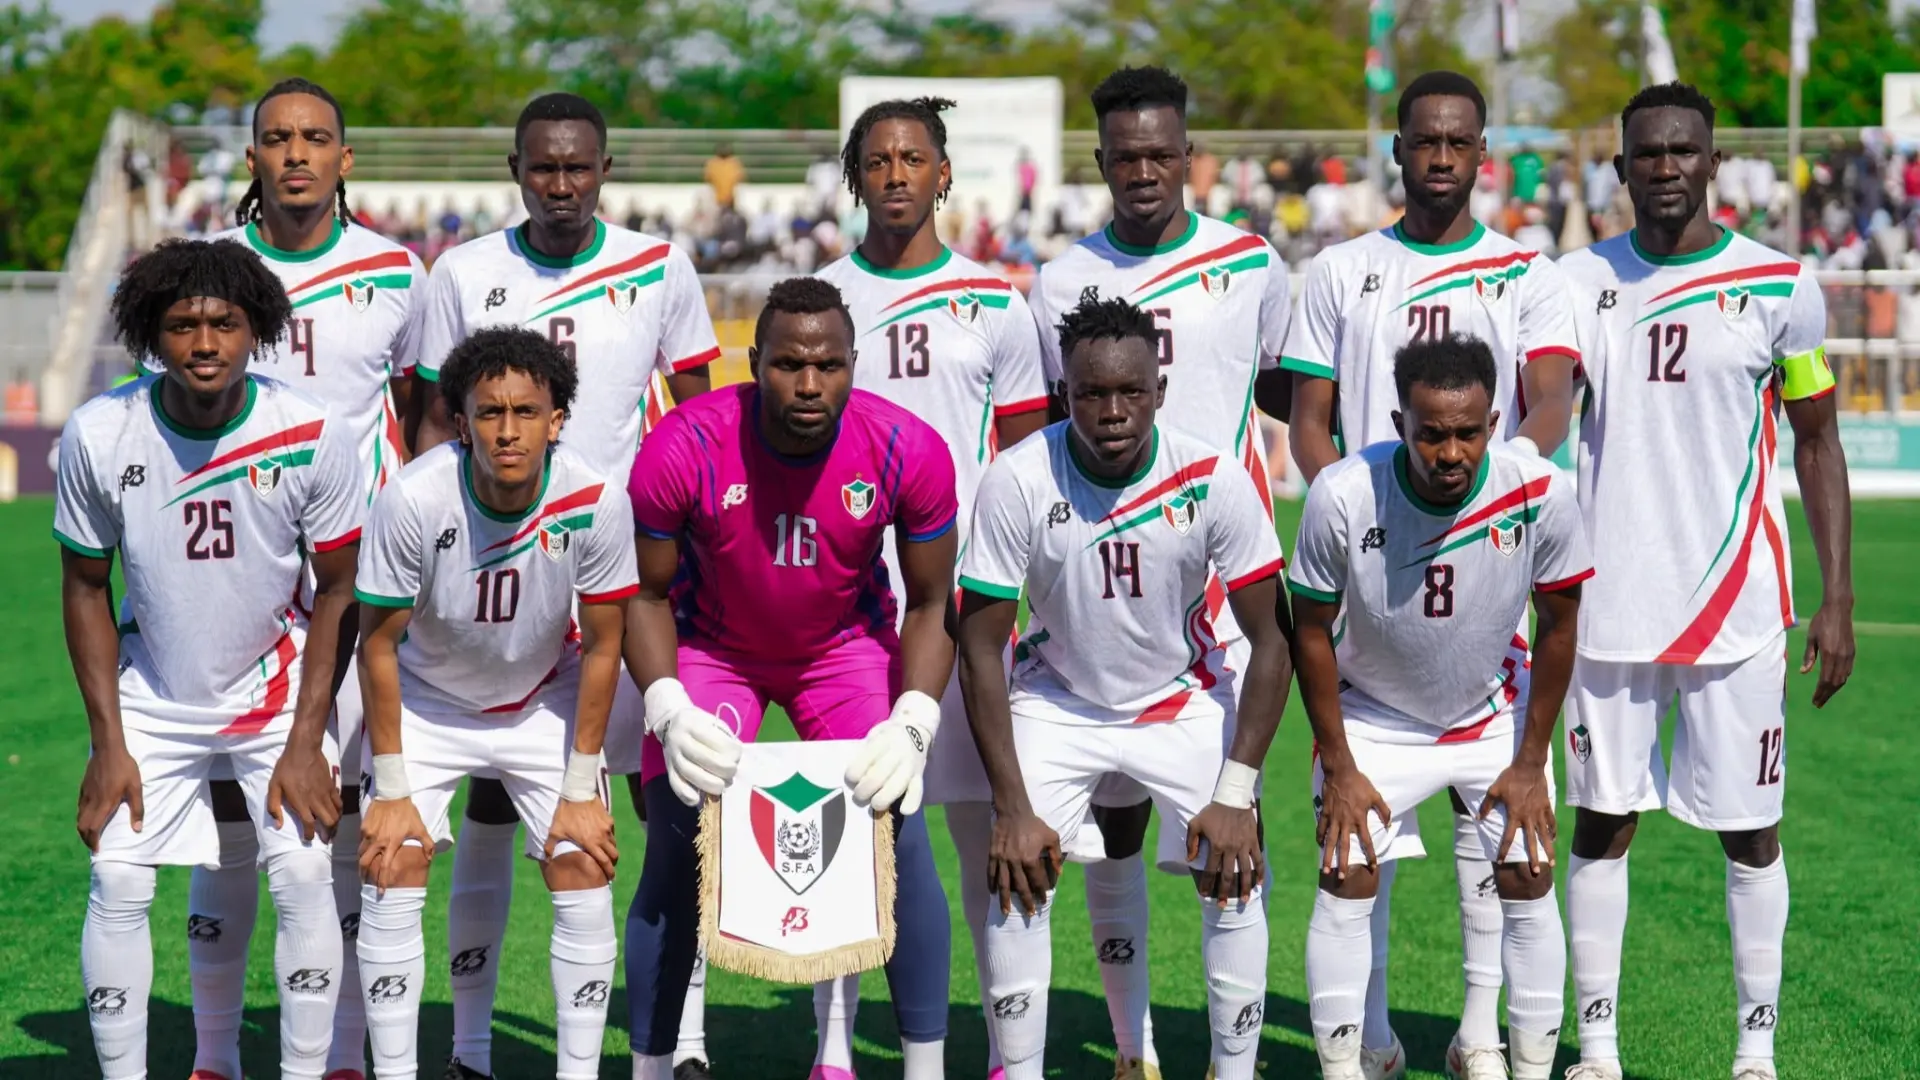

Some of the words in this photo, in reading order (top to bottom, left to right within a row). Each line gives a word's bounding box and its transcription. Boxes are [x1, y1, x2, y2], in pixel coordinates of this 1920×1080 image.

[287, 318, 316, 377] 4
[886, 323, 931, 379] 13
[1647, 323, 1687, 382] 12
[183, 500, 235, 560] 25
[773, 513, 818, 567] 16
[473, 567, 521, 623] 10
[1098, 540, 1144, 599] 14
[1423, 564, 1455, 618] 8
[1756, 727, 1781, 786] 12
[782, 862, 815, 875] S.F.A
